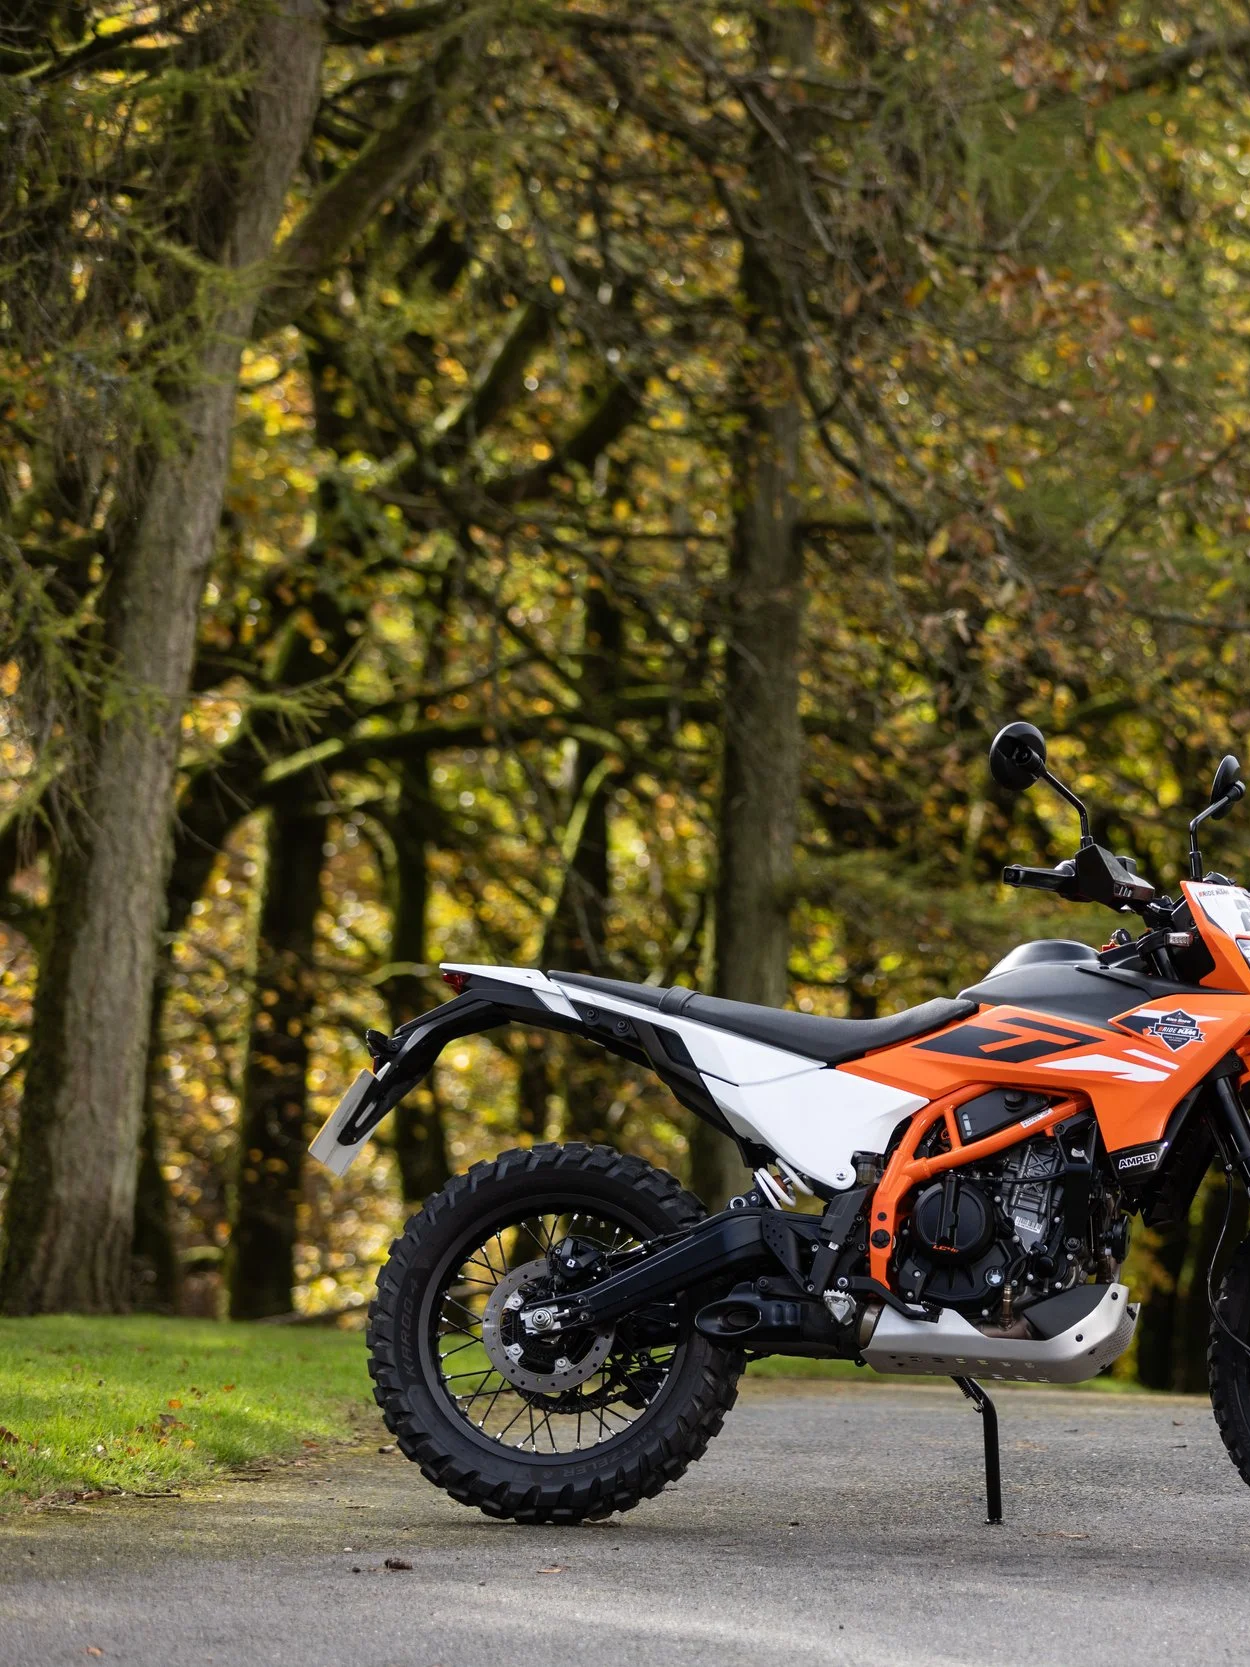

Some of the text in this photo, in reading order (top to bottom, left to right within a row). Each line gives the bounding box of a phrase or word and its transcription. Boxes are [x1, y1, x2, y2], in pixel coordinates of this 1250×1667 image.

[1118, 1152, 1158, 1170] AMPED
[401, 1297, 417, 1377] KAROO
[563, 1429, 655, 1478] METZELER
